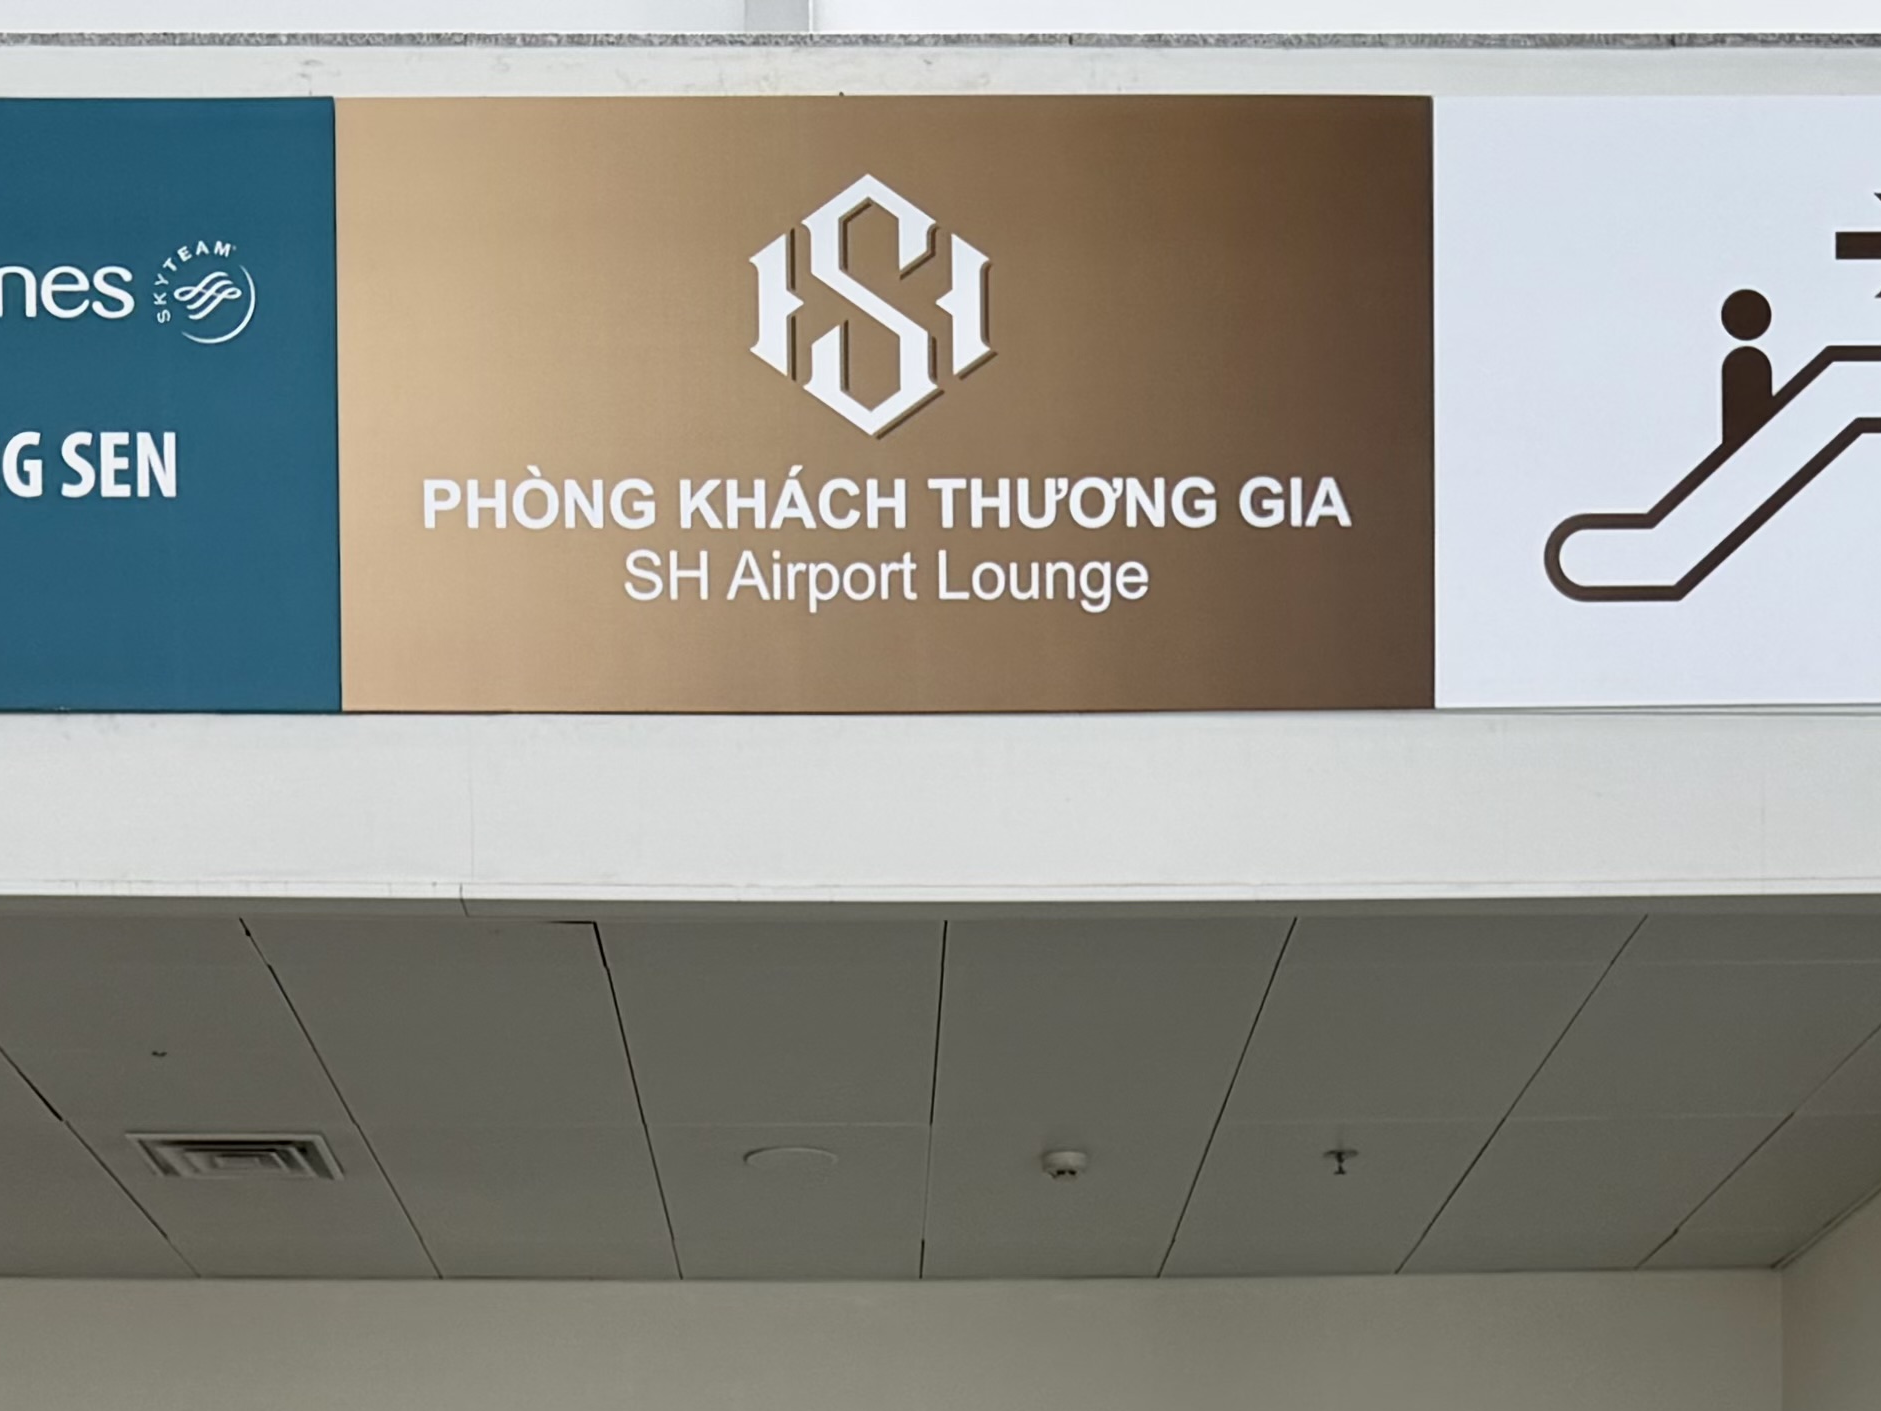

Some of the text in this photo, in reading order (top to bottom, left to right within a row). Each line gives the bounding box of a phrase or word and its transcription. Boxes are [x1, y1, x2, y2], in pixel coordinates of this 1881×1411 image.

[154, 241, 231, 323] SKYTEAM
[61, 430, 178, 499] SEN
[422, 464, 1351, 530] PHÒNG KHÁCH THƯƠNG GIA
[625, 549, 1149, 612] SH Airport Lounge
